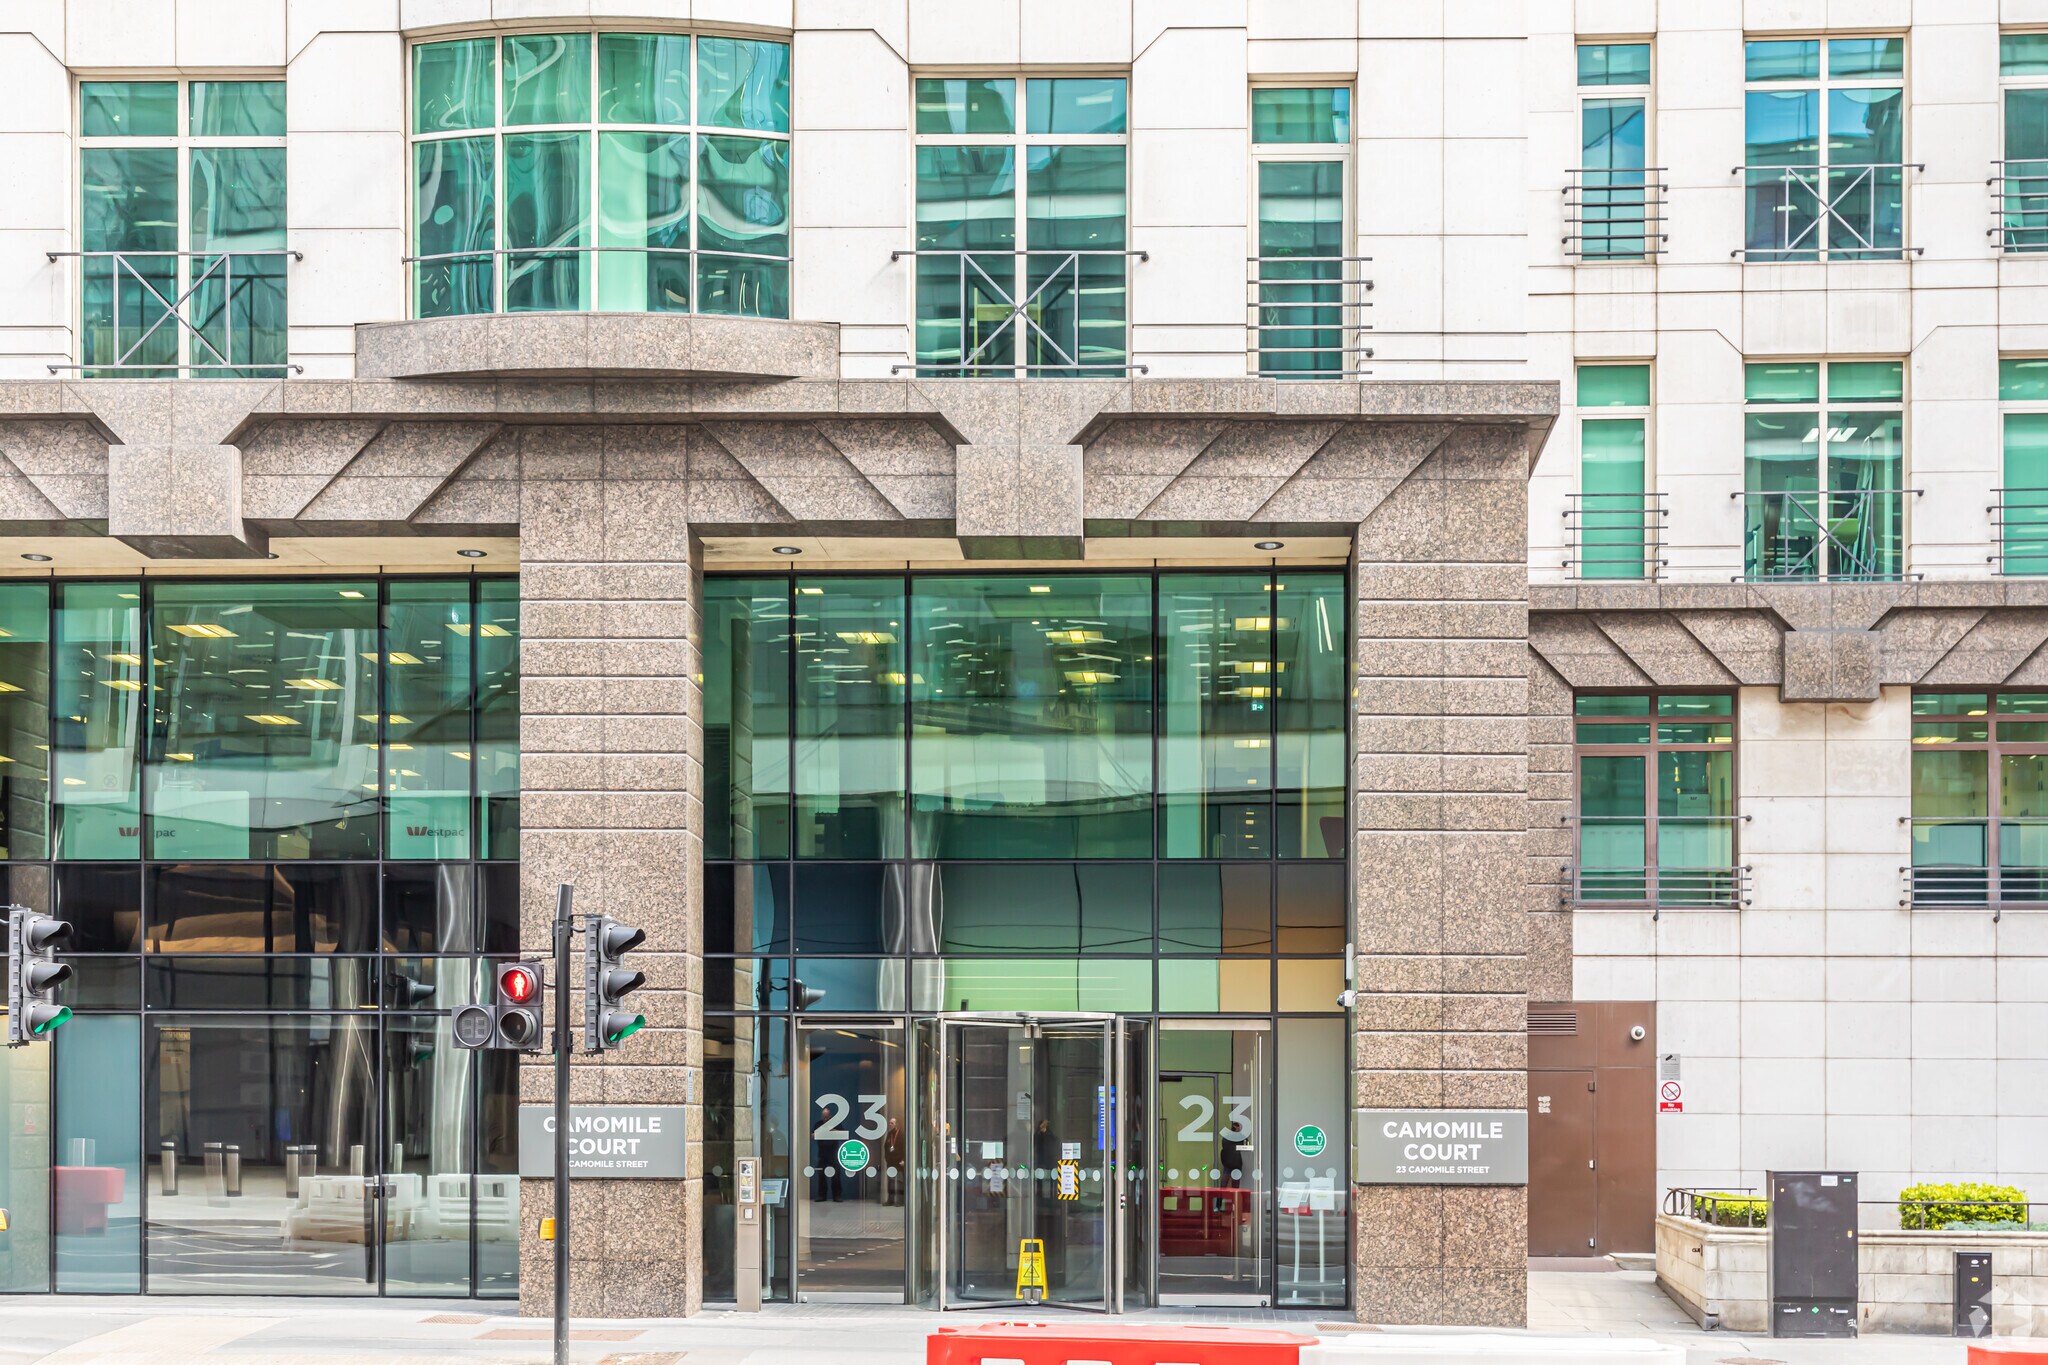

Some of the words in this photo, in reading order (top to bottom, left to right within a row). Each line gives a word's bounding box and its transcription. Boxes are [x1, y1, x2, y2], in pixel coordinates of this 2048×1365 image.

[119, 827, 176, 838] Wpac
[407, 826, 464, 838] Westpac
[814, 1093, 888, 1140] 23
[1177, 1094, 1253, 1142] 23
[1382, 1121, 1503, 1139] CAMOMILE
[1403, 1143, 1482, 1161] COURT
[569, 1160, 614, 1168] CAMOMILE
[616, 1160, 648, 1168] STREET
[1396, 1165, 1407, 1174] 23
[1408, 1165, 1455, 1174] CAMOMILE
[1457, 1165, 1490, 1174] STREET
